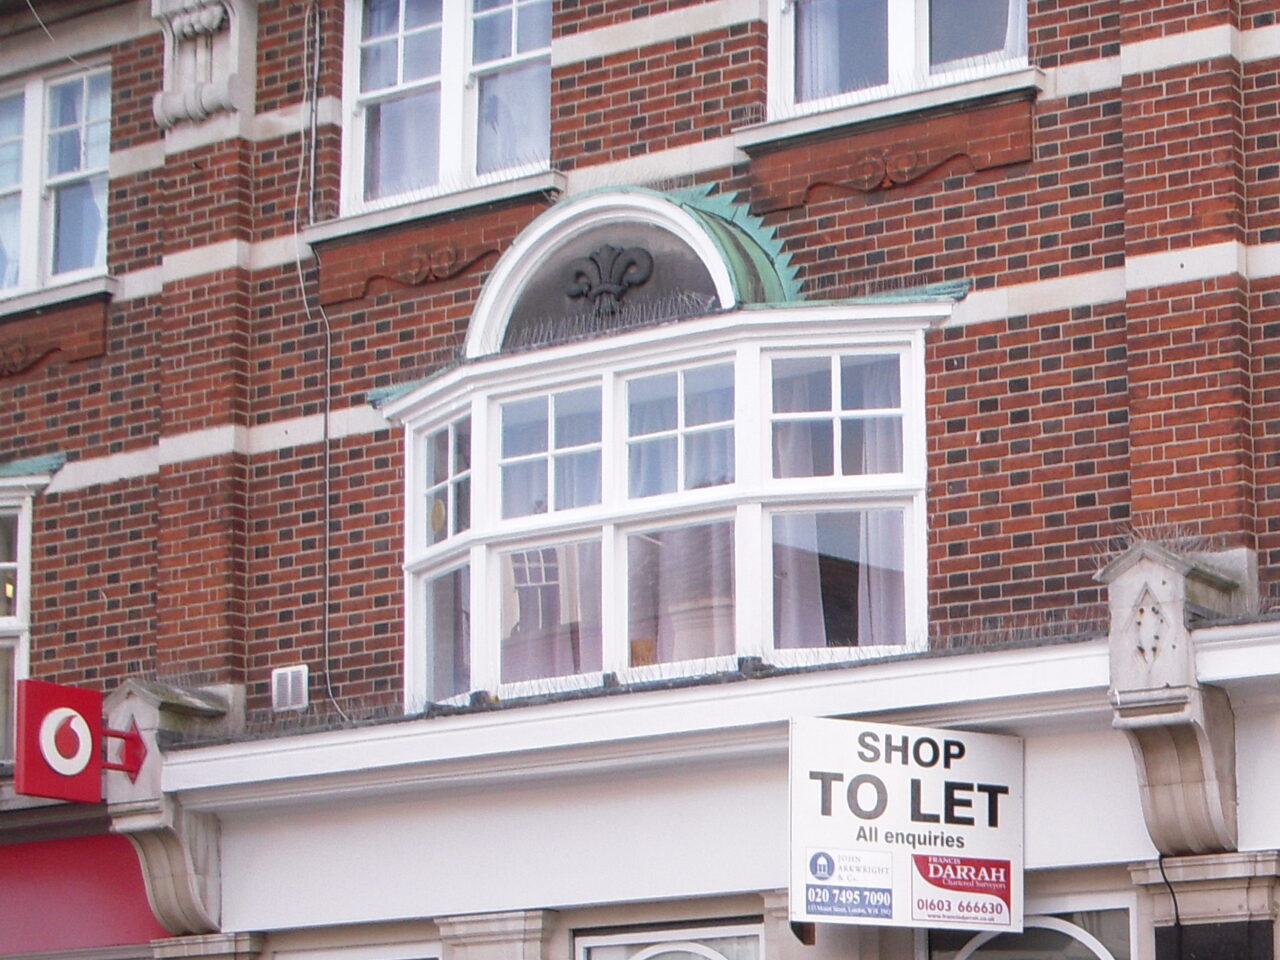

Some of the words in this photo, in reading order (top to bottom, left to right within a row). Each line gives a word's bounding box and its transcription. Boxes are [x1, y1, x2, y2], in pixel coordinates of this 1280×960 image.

[857, 731, 966, 769] SHOP
[809, 770, 889, 820] TO
[910, 778, 1009, 828] LET
[856, 826, 878, 843] All
[884, 830, 965, 849] enquiries
[928, 856, 960, 864] FRANCIS
[928, 863, 1006, 882] DARRAH
[943, 879, 974, 887] Chartered
[808, 887, 829, 903] 020
[832, 889, 860, 905] 7495
[863, 891, 891, 906] 7090
[917, 899, 951, 912] 01603
[958, 901, 1003, 914] 666630
